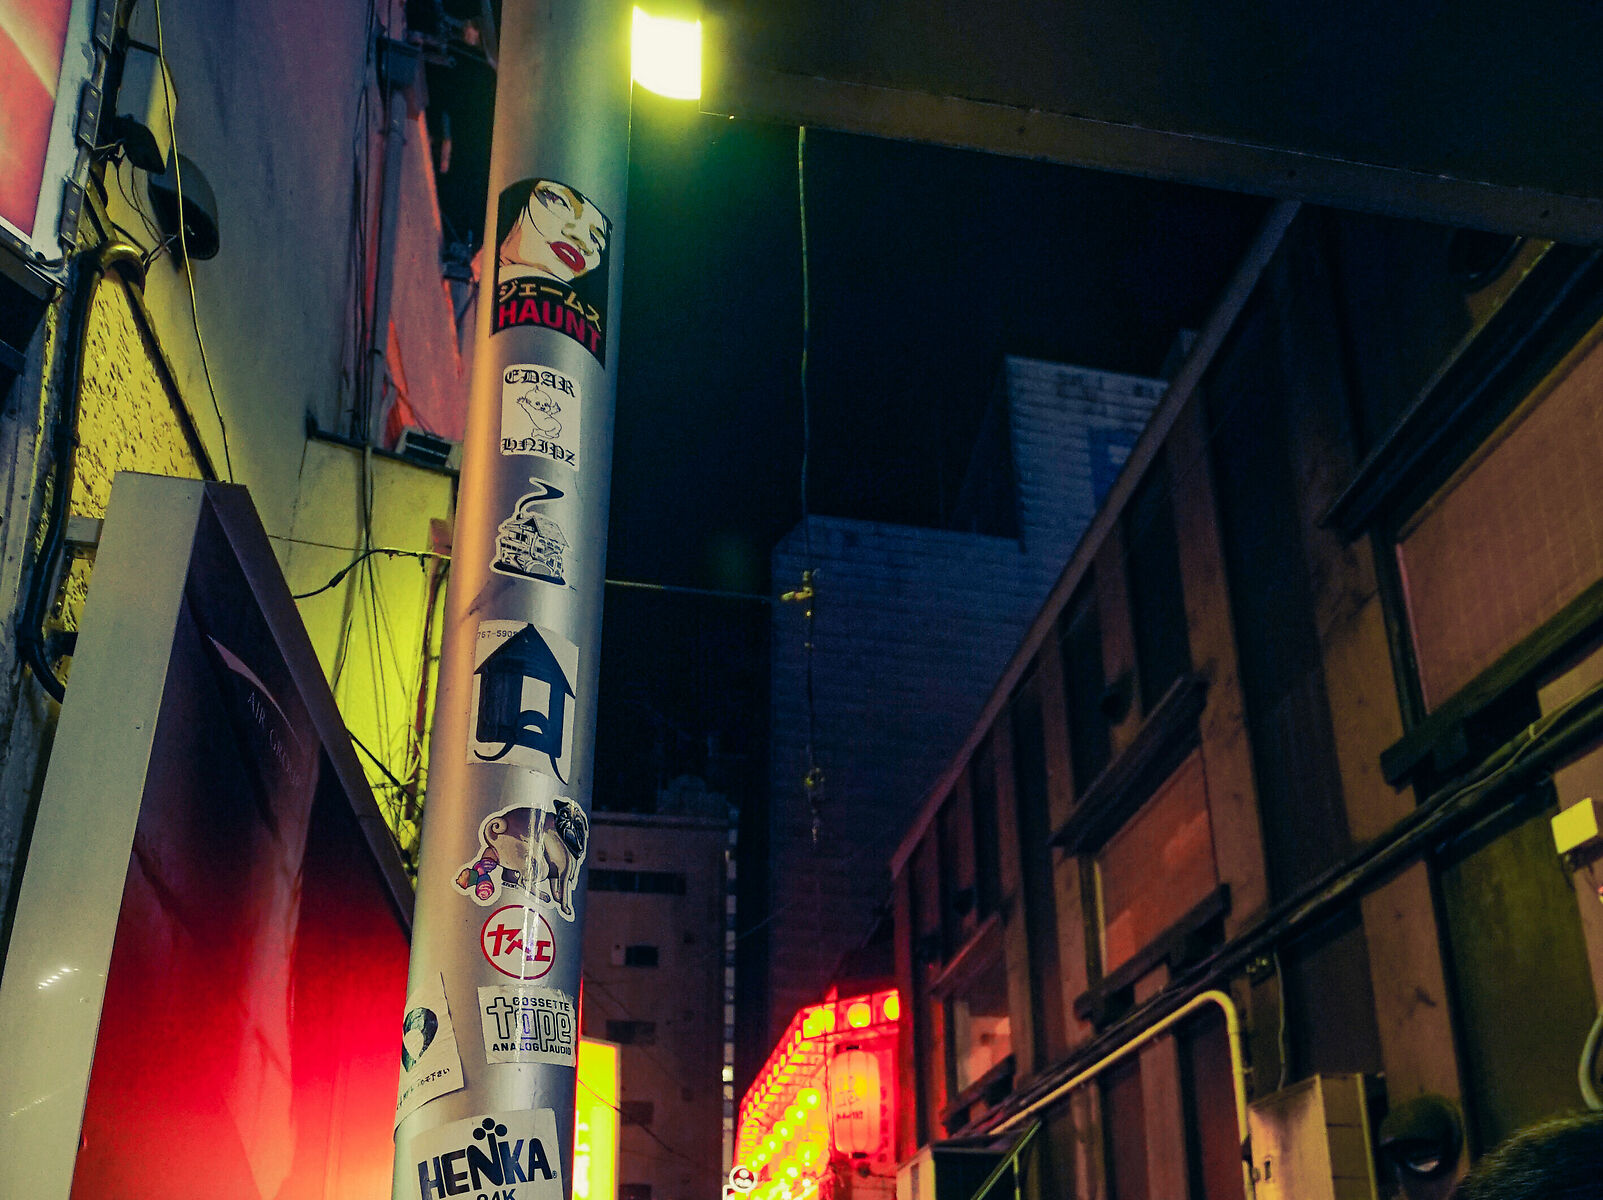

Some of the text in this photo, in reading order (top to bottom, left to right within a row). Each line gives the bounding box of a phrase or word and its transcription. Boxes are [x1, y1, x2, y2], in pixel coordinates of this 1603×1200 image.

[499, 299, 601, 352] HAUNT
[492, 1042, 572, 1056] ANALOG AUDIO
